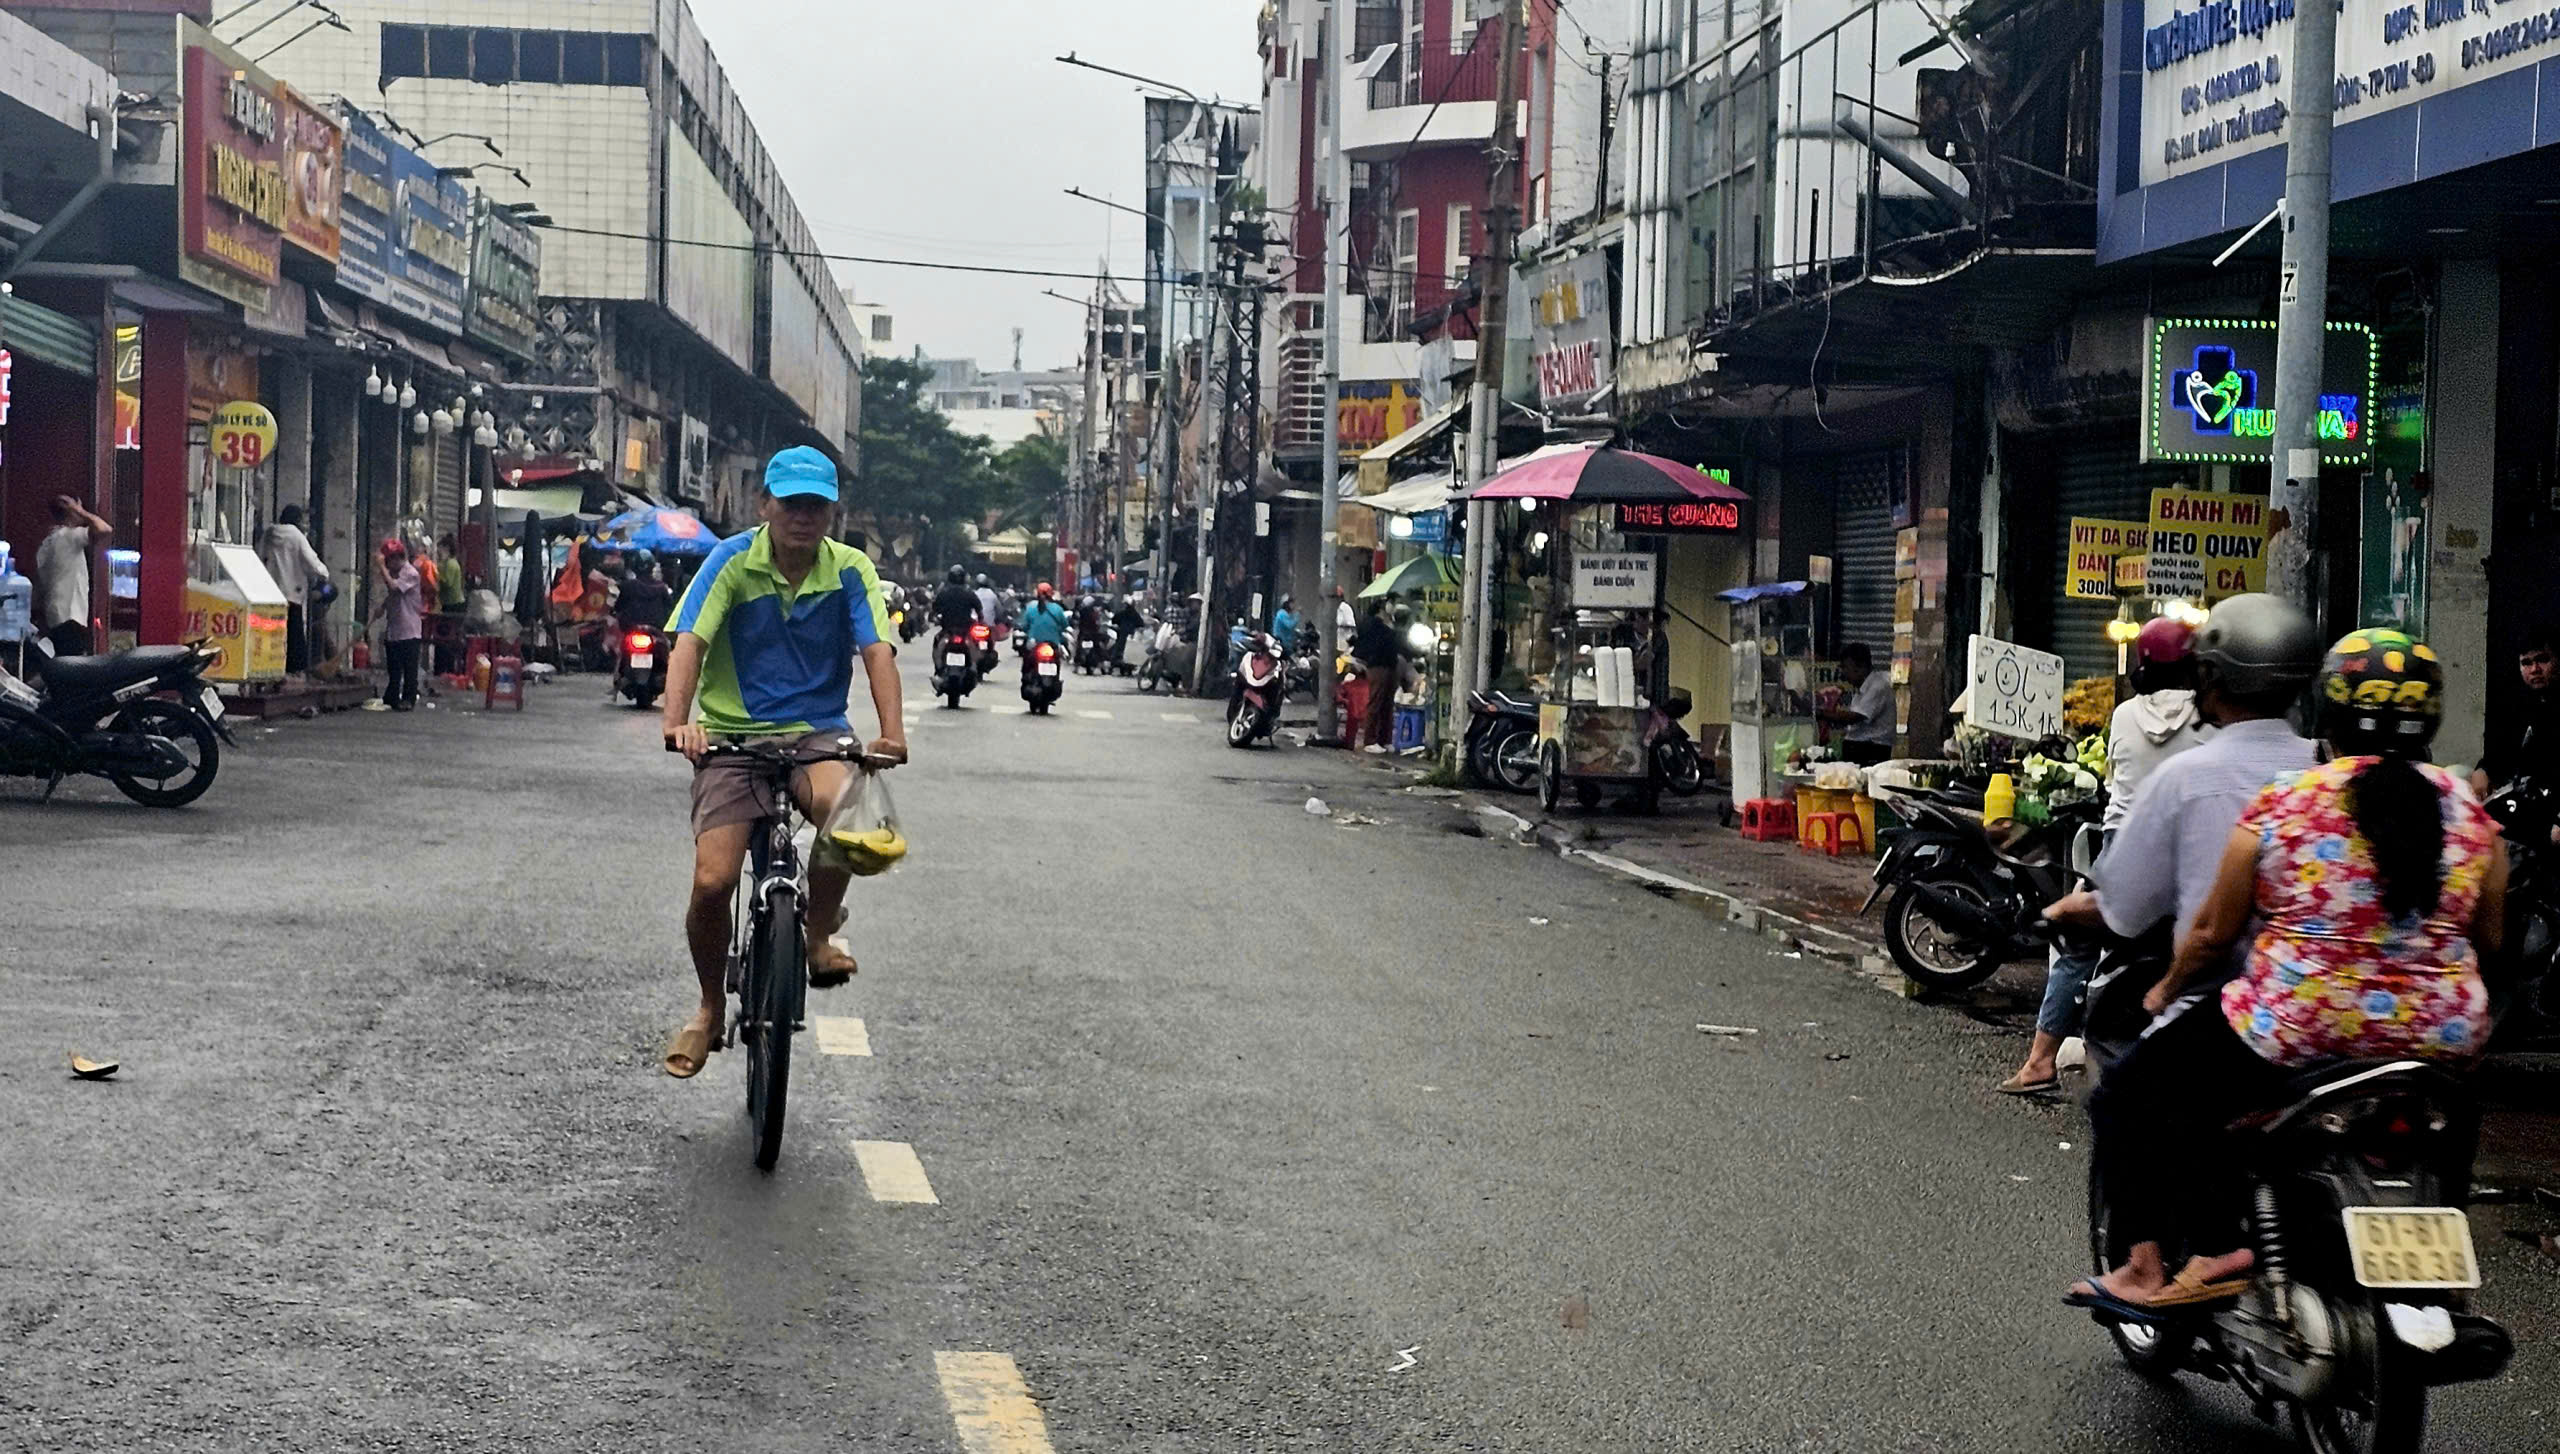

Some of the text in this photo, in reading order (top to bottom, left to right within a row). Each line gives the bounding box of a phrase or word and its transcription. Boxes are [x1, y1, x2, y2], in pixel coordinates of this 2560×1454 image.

[2283, 272, 2295, 293] 7
[221, 431, 262, 466] 39
[1668, 502, 1738, 529] QUANG
[2160, 494, 2262, 526] BÁNH MÌ
[2075, 525, 2098, 549] VỊT
[2102, 528, 2121, 546] DA
[2152, 530, 2263, 560] HEO QUAY
[2179, 559, 2200, 569] HEO
[2216, 565, 2247, 591] CÁ
[211, 606, 242, 638] SỐ
